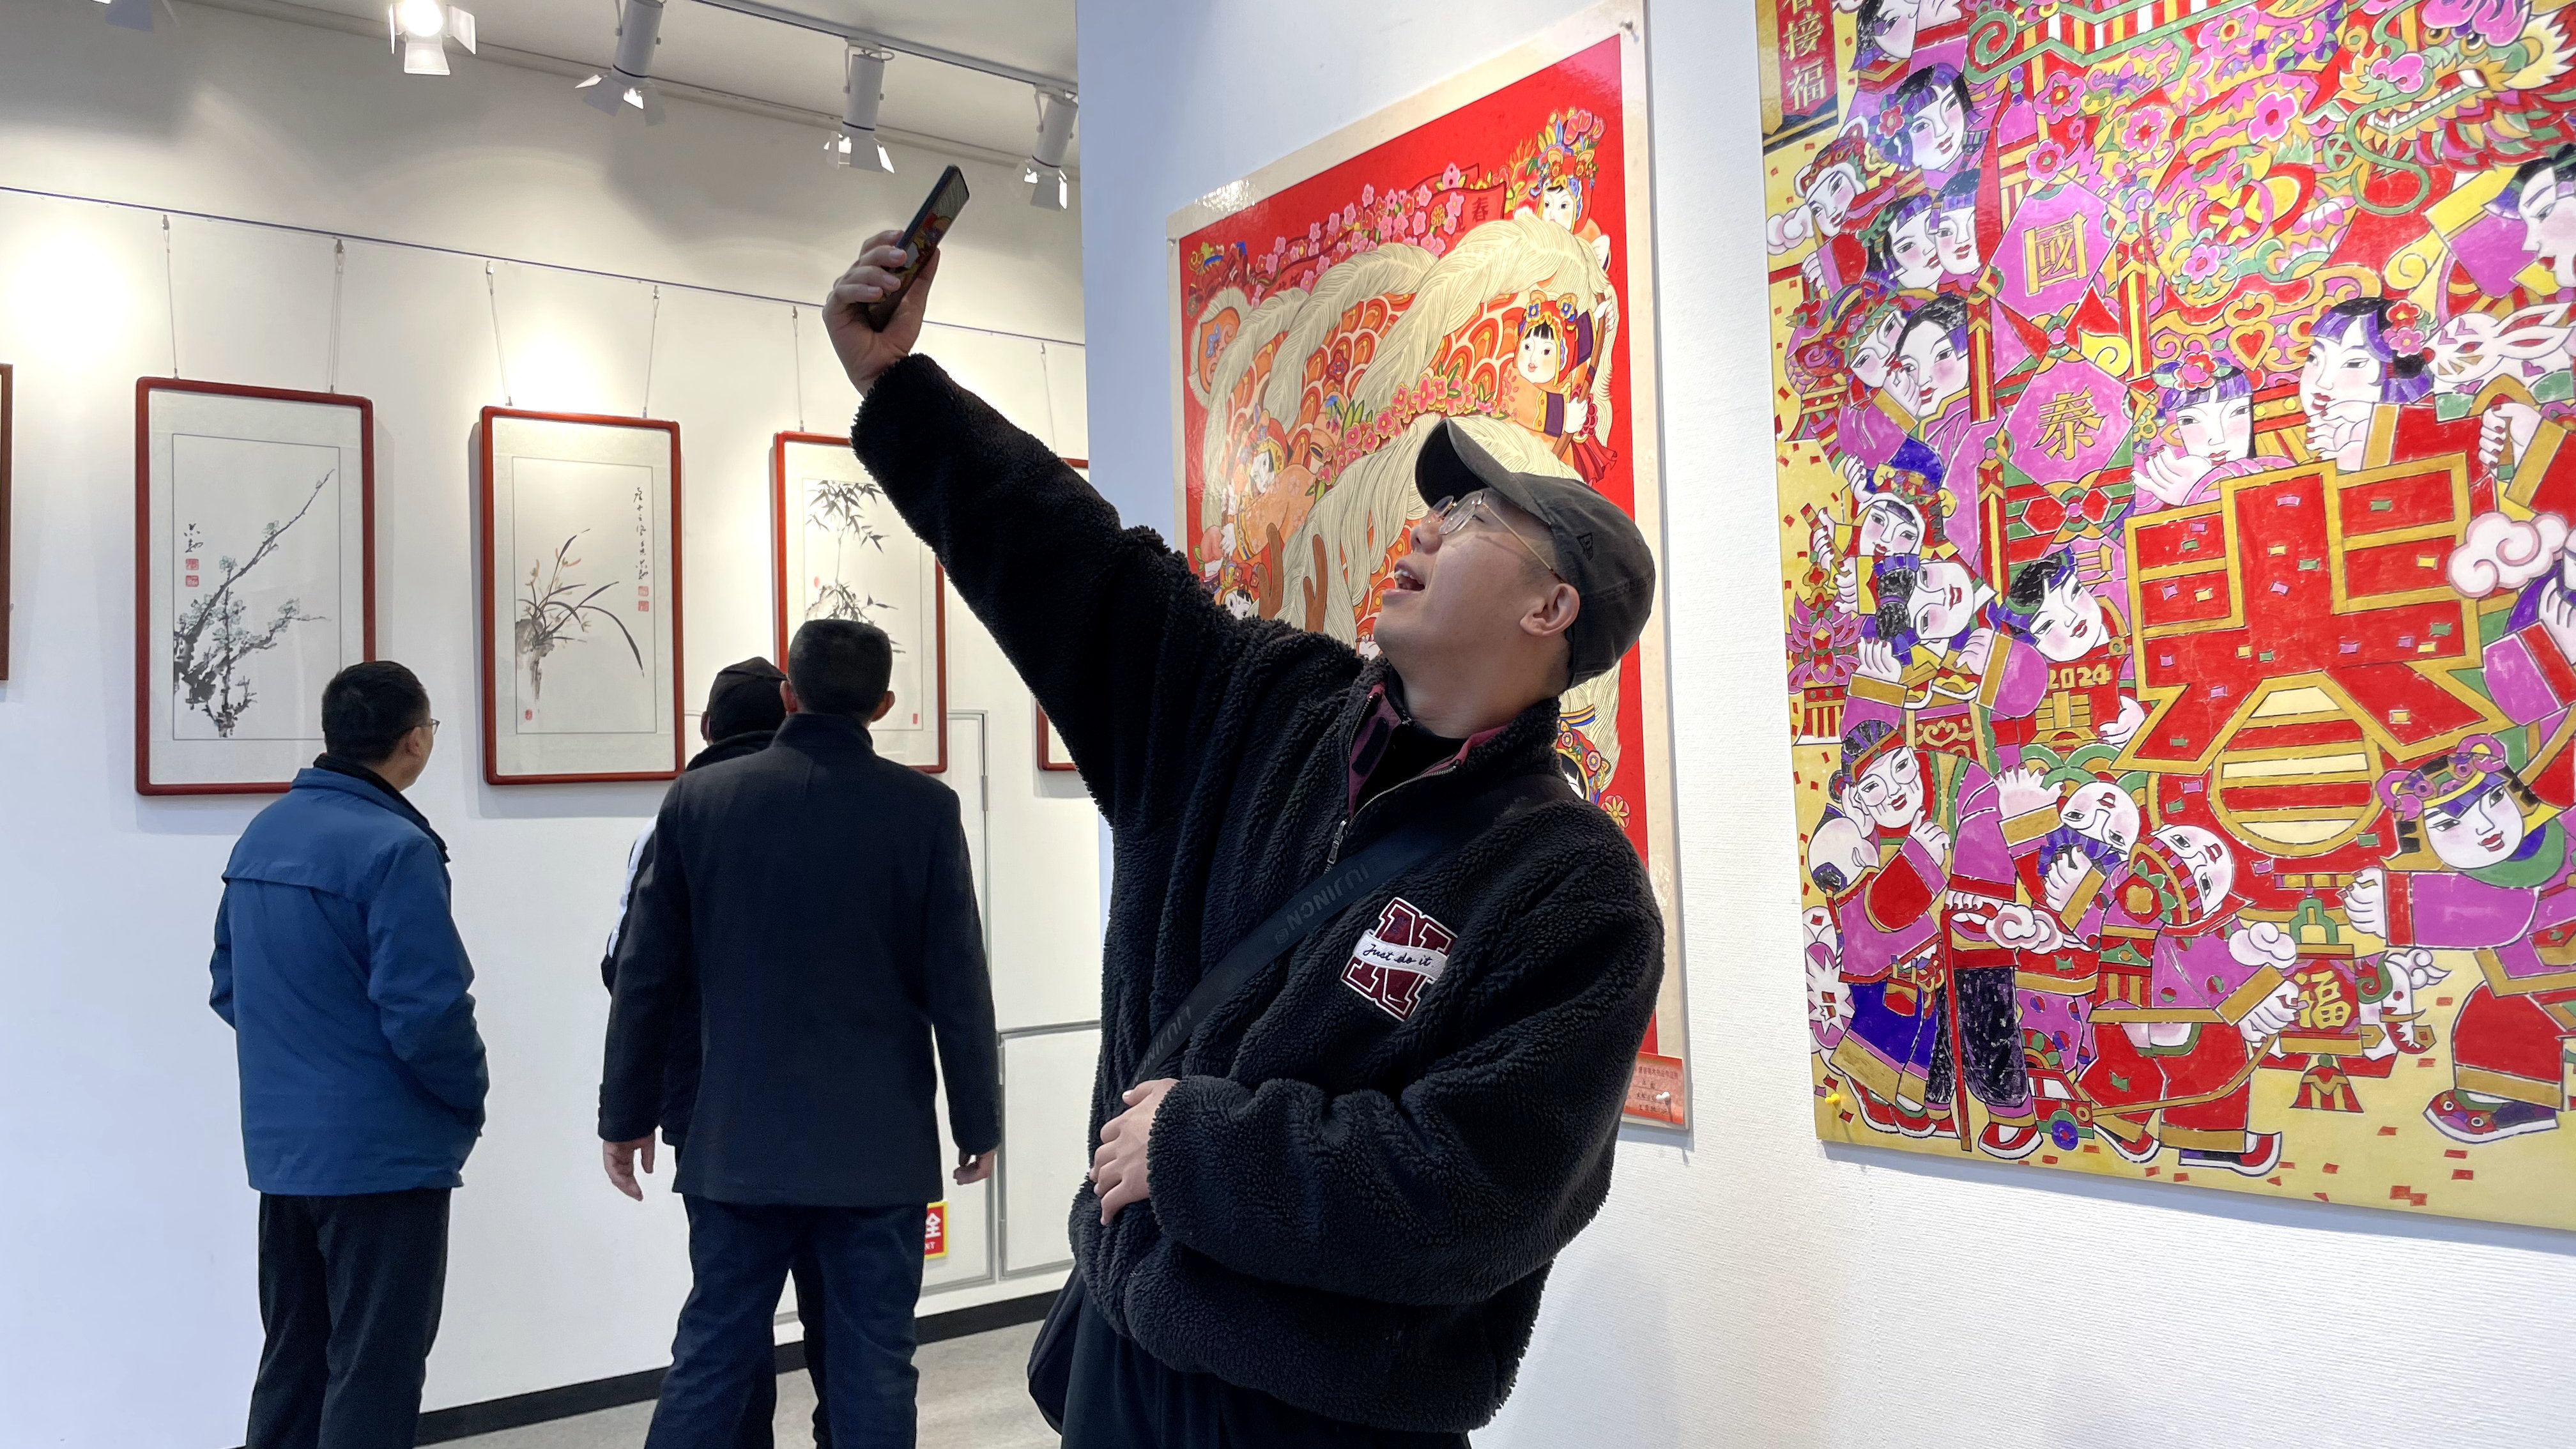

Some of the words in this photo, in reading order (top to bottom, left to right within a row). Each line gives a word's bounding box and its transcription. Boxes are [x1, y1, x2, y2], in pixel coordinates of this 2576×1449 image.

[1472, 196, 1489, 222] 春
[2023, 210, 2089, 296] 國
[2032, 385, 2108, 461] 泰
[2047, 663, 2112, 690] 2024
[1362, 943, 1395, 961] Just
[1393, 952, 1417, 964] do
[2293, 970, 2352, 1030] 福
